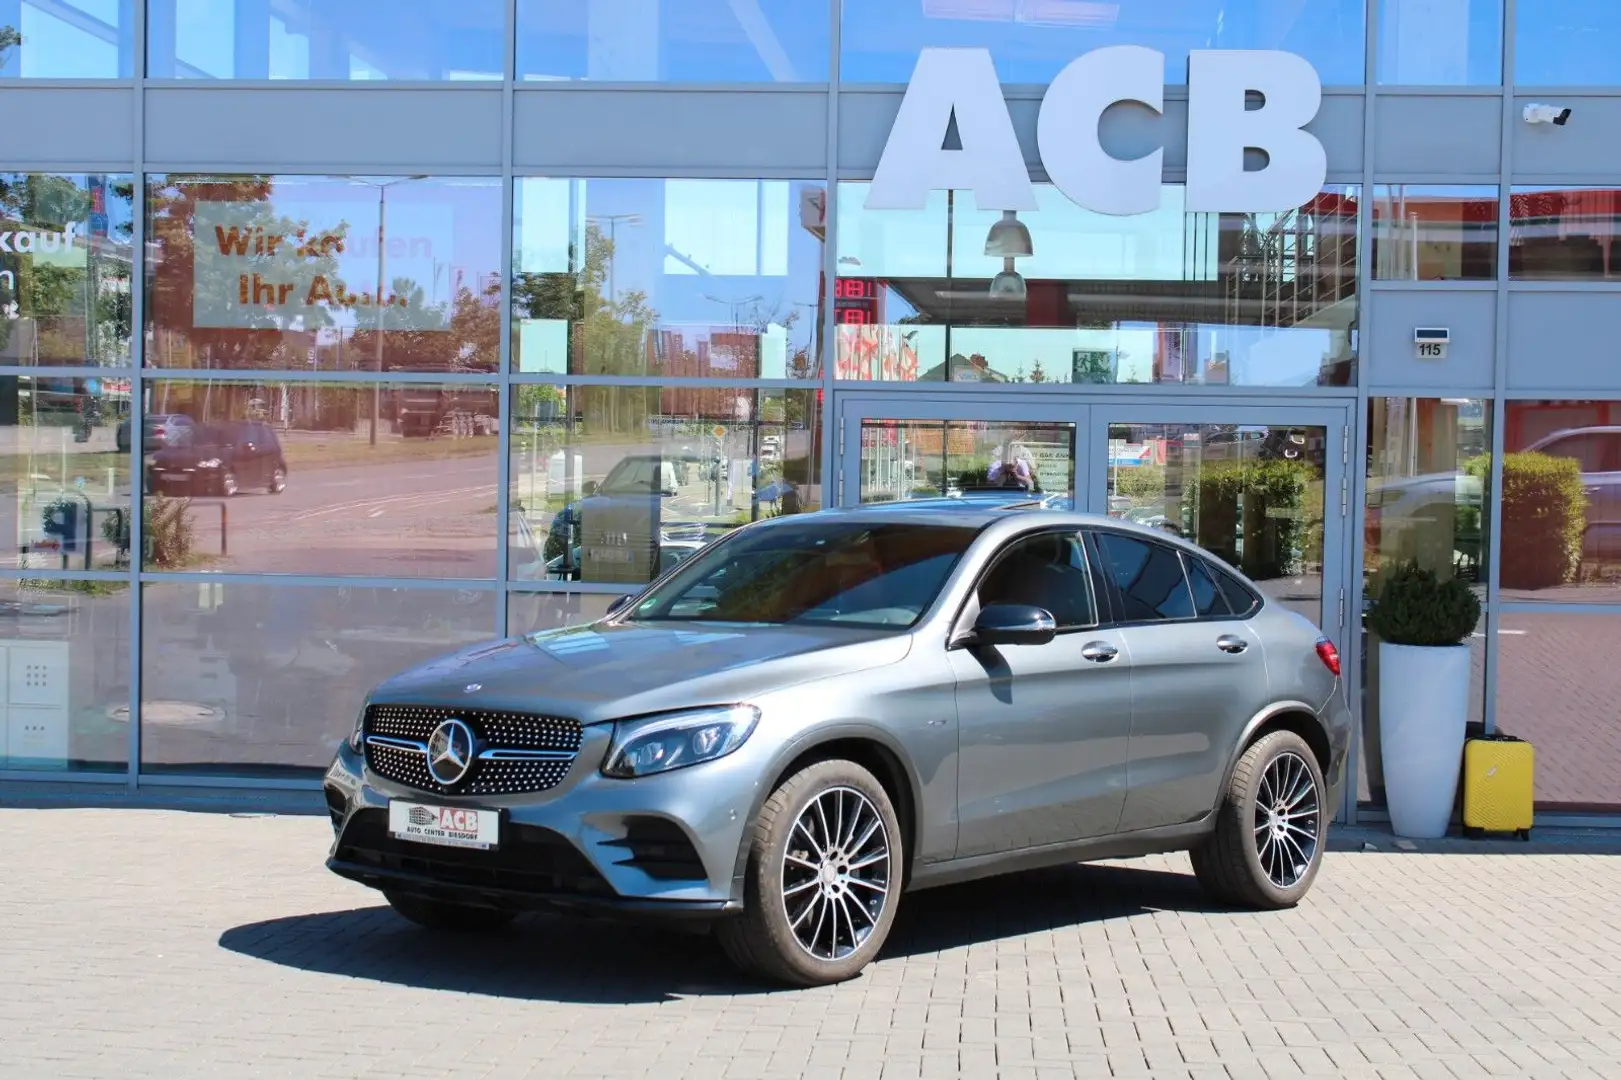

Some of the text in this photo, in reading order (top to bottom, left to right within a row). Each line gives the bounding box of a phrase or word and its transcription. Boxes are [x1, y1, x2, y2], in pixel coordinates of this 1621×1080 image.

[862, 44, 1328, 216] ACB
[214, 223, 284, 257] Wir
[239, 271, 294, 305] Ihr
[1419, 343, 1441, 356] 115
[406, 826, 422, 834] AUTO
[424, 828, 445, 837] CENTER
[441, 808, 477, 831] ACB
